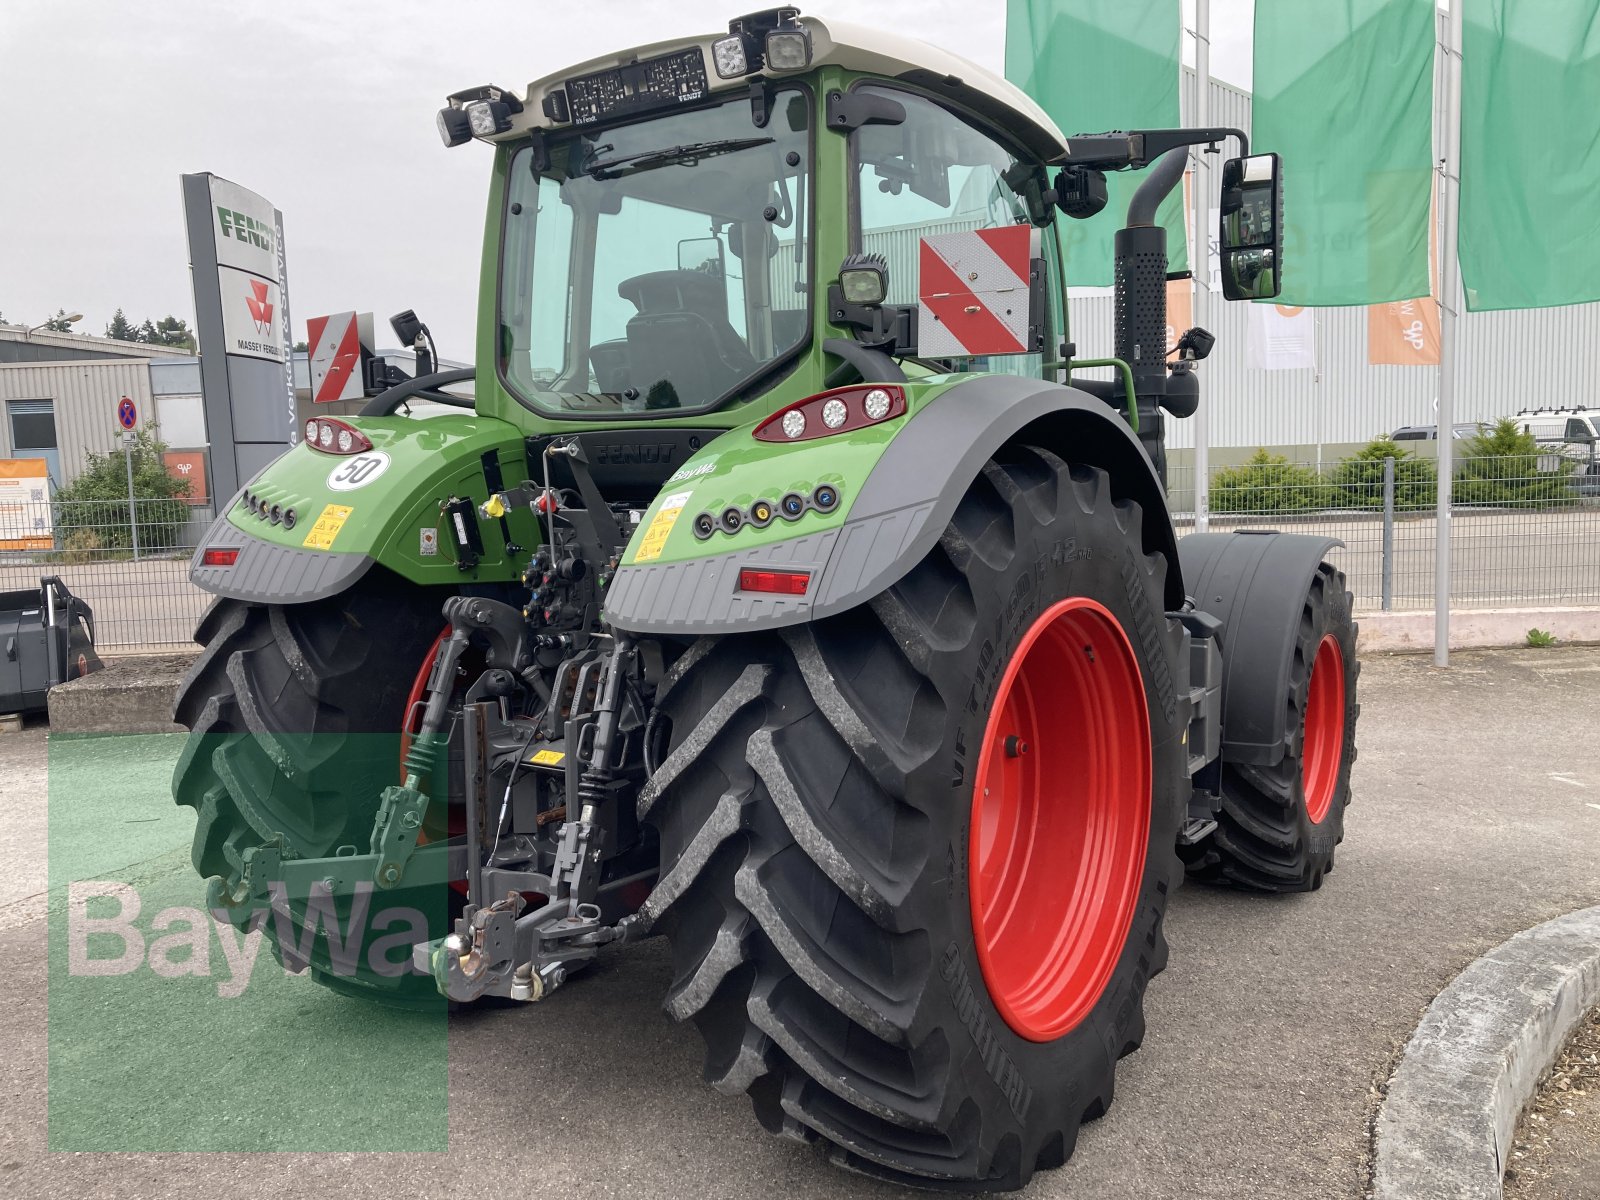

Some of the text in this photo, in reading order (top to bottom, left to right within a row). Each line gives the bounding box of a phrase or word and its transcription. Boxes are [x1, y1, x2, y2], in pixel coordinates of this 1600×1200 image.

[678, 91, 702, 102] FENDT
[216, 205, 275, 255] FENDT
[237, 339, 262, 353] MASSEY
[592, 443, 677, 464] FENDT
[335, 456, 382, 484] 50
[670, 462, 717, 482] BayWa
[938, 939, 1034, 1130] TRELLEBORG
